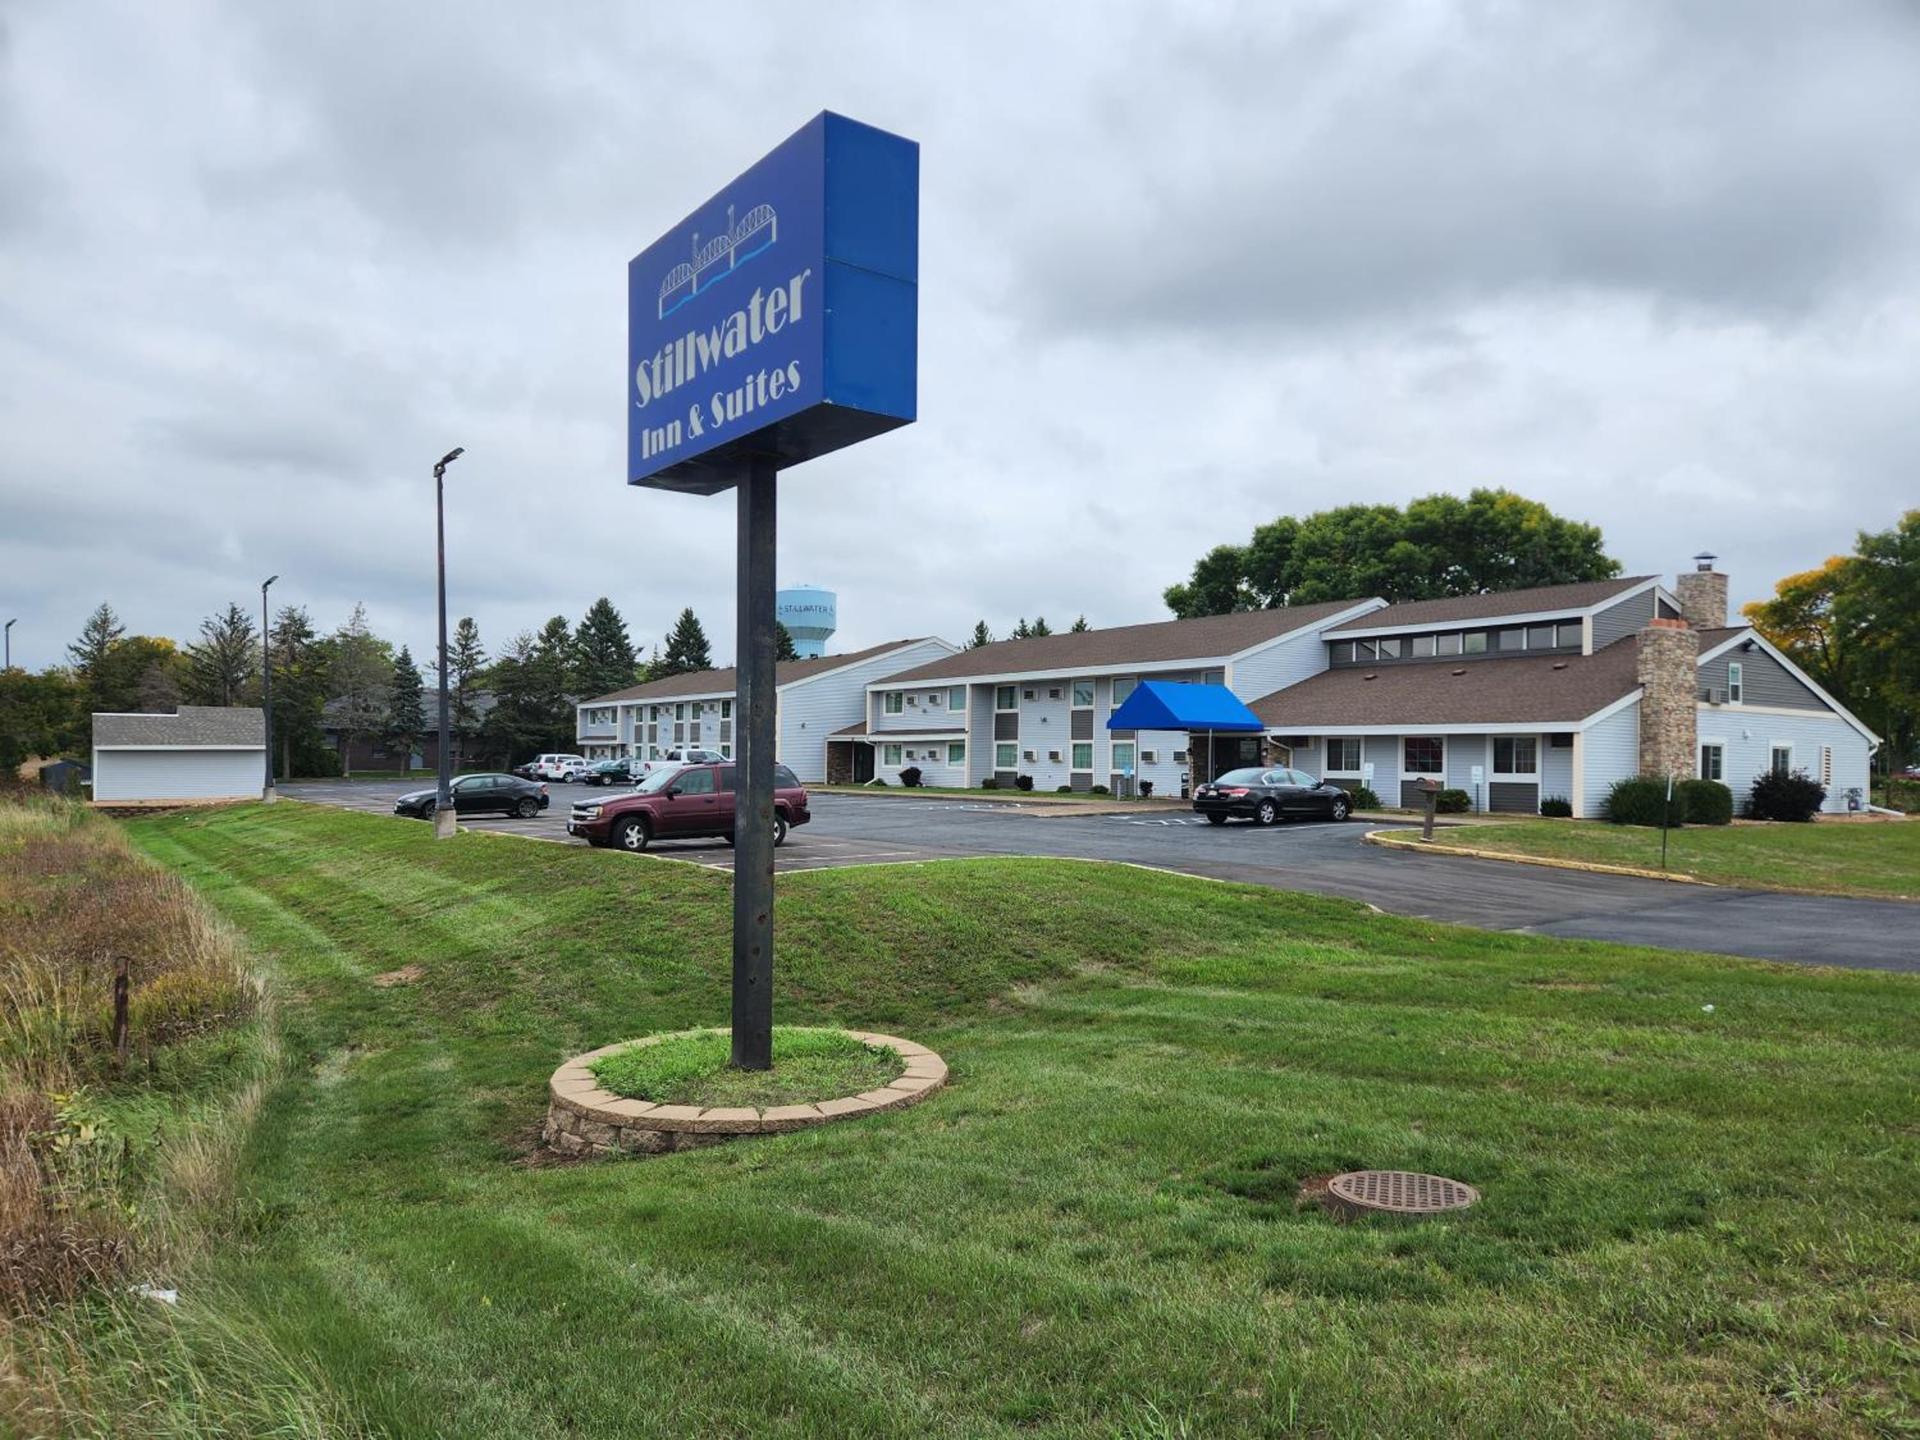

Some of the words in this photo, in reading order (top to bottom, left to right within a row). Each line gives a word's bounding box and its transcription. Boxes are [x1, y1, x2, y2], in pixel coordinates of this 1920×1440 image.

[636, 269, 811, 408] Stillwater
[642, 419, 682, 460] Inn
[688, 403, 705, 440] &
[711, 360, 801, 429] Suites
[784, 604, 828, 613] STILLWATER
